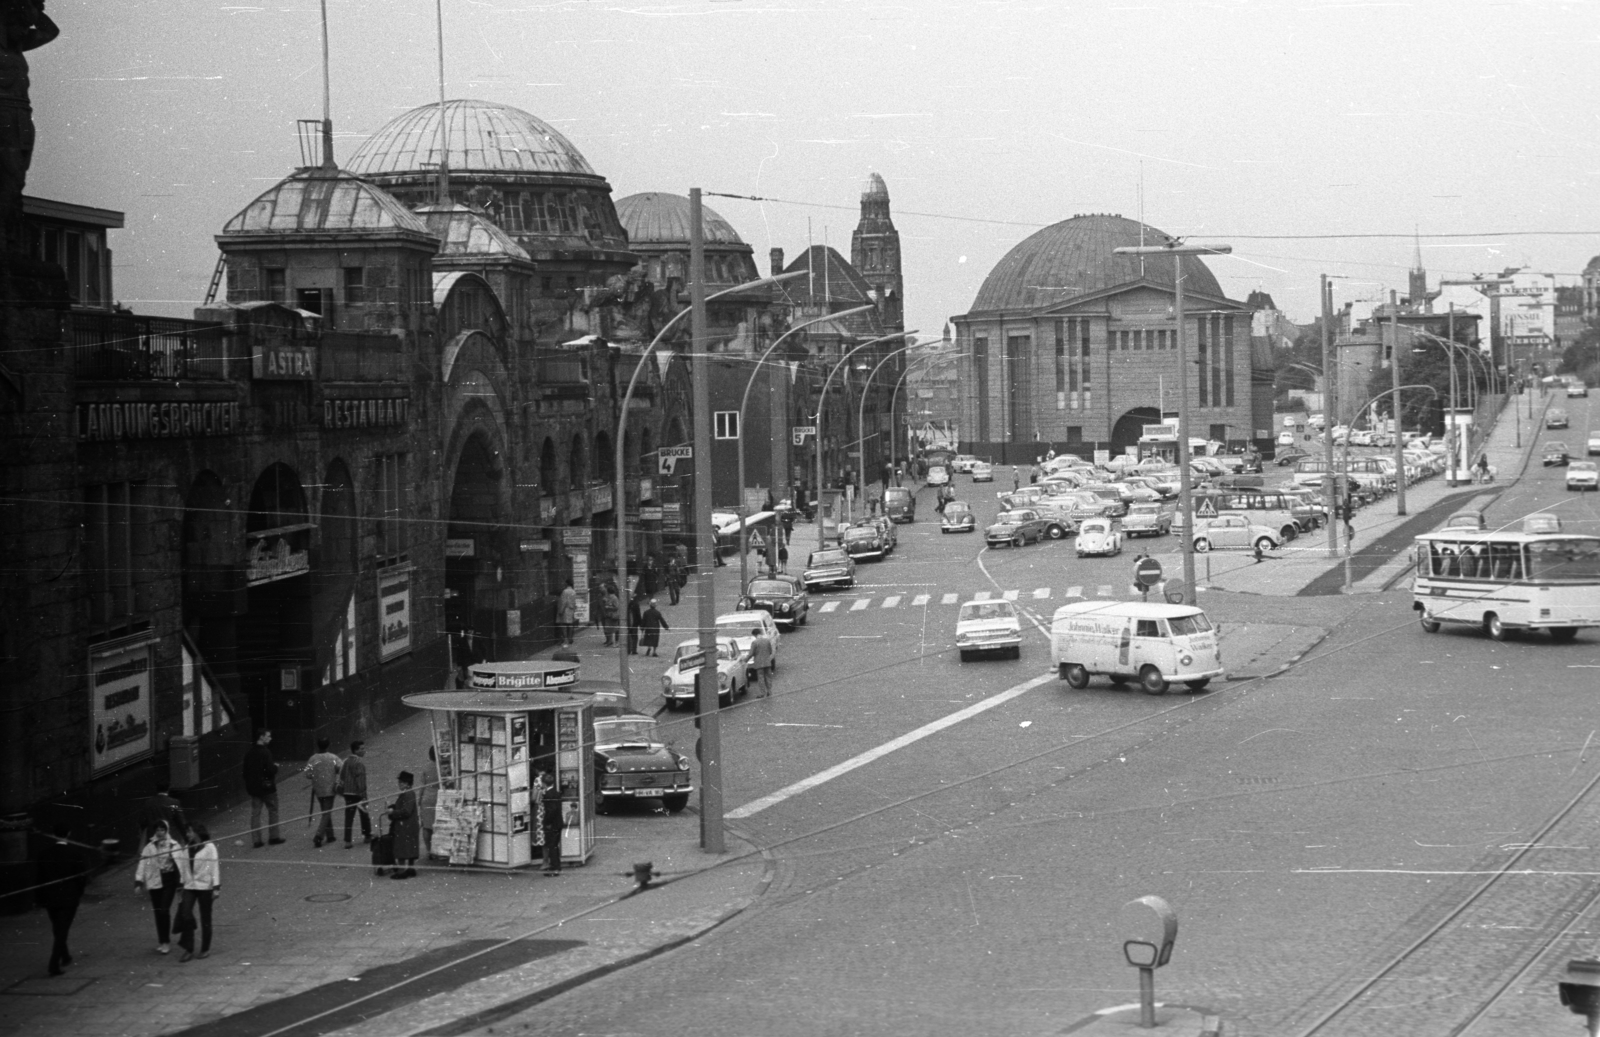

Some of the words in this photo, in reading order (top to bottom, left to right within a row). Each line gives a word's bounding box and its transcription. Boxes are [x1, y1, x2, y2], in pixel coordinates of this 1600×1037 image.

[268, 351, 313, 375] ASTRA
[76, 402, 239, 443] LANDUNGSBRÜCKEN
[324, 398, 409, 429] RESTAURANT
[795, 434, 801, 444] 5
[662, 458, 671, 472] 4
[498, 675, 541, 687] Brigitte
